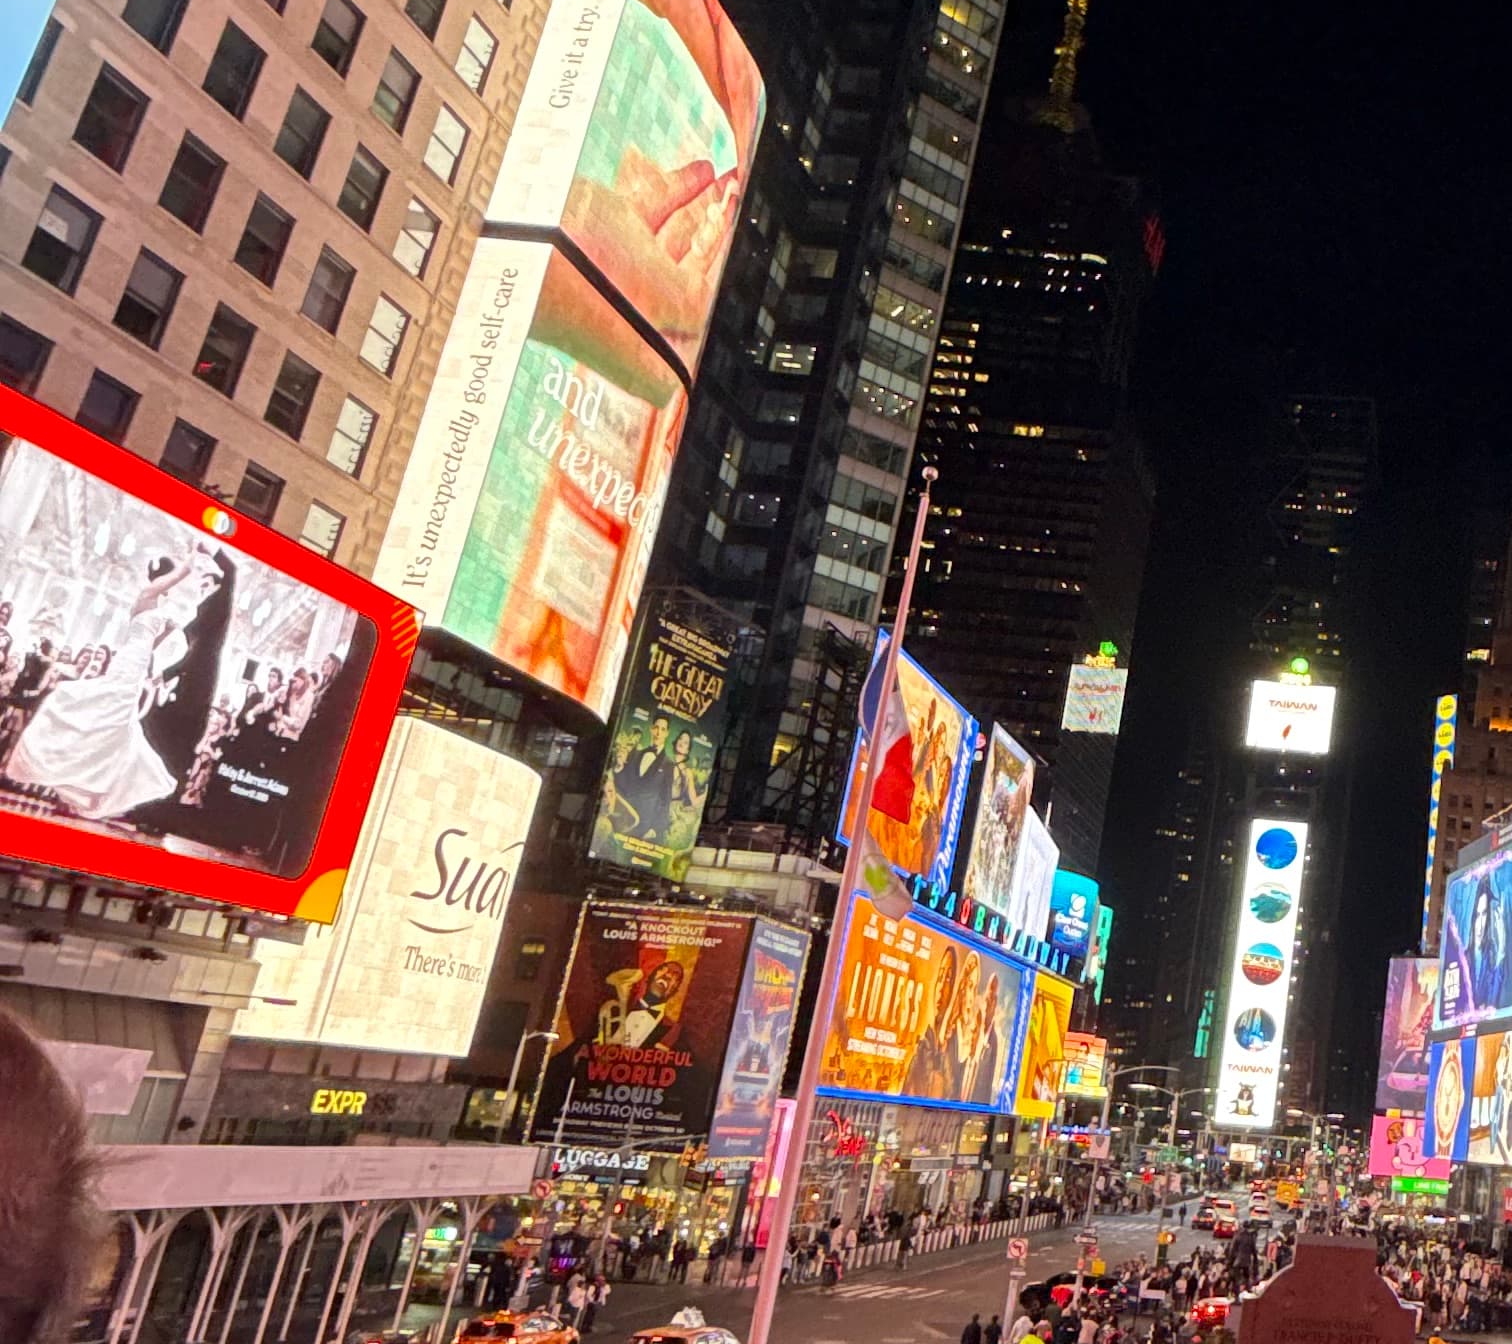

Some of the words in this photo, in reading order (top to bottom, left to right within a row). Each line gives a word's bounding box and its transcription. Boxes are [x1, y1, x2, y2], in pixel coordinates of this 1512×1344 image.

[573, 5, 601, 32] try.
[573, 38, 589, 48] a
[561, 52, 585, 64] it
[549, 69, 579, 109] Give
[543, 357, 605, 430] and
[401, 552, 434, 589] It's
[422, 409, 480, 554] unexpectedly
[464, 354, 493, 406] good
[480, 267, 520, 350] self-care
[677, 662, 724, 701] GREAT
[651, 676, 713, 718] GATSBY
[1268, 699, 1318, 711] TAIWAN
[603, 929, 638, 941] LOUIS
[640, 922, 707, 935] KNOCKOUT
[403, 945, 456, 977] There's
[846, 961, 924, 1033] LIONESS
[588, 1060, 677, 1088] WORLD
[1227, 1063, 1274, 1075] TAIWAN
[604, 1084, 665, 1105] LOUIS
[561, 1101, 654, 1119] ARMSTRONG
